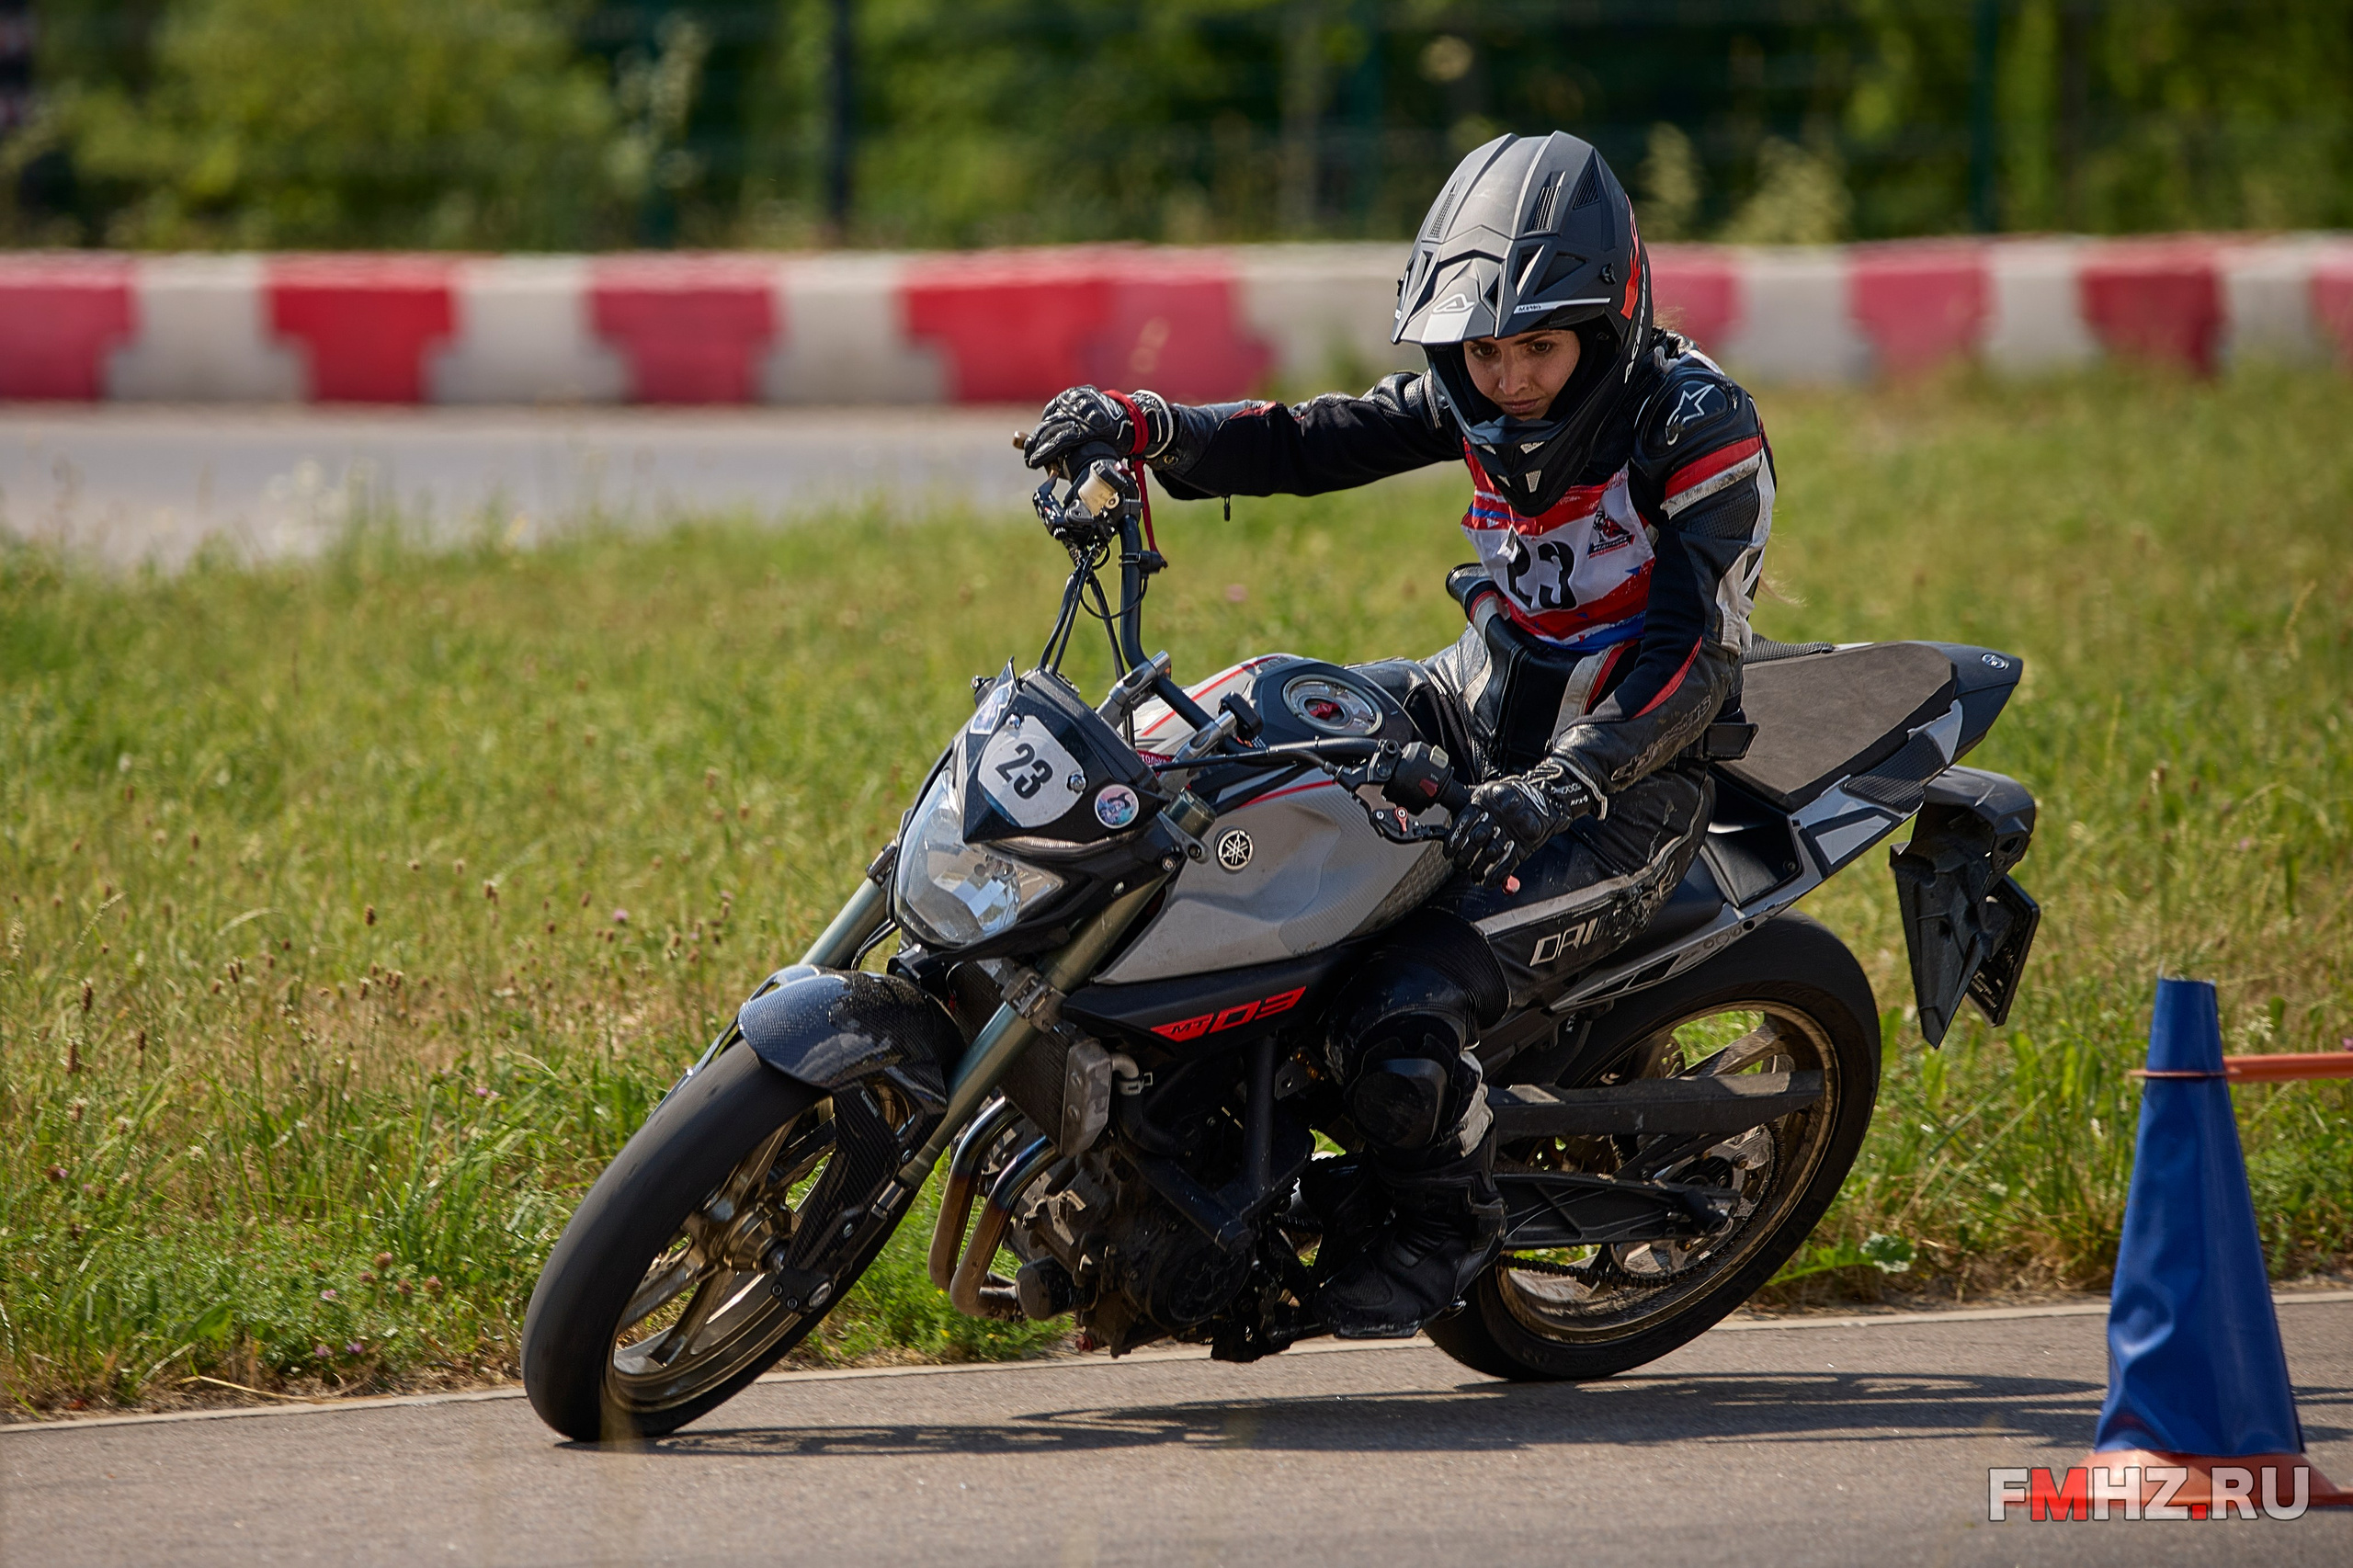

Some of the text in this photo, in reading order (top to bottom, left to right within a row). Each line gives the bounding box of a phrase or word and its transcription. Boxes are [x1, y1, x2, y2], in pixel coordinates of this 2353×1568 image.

[1506, 528, 1578, 611] 23
[995, 743, 1053, 801] 23
[1209, 985, 1307, 1035] 03
